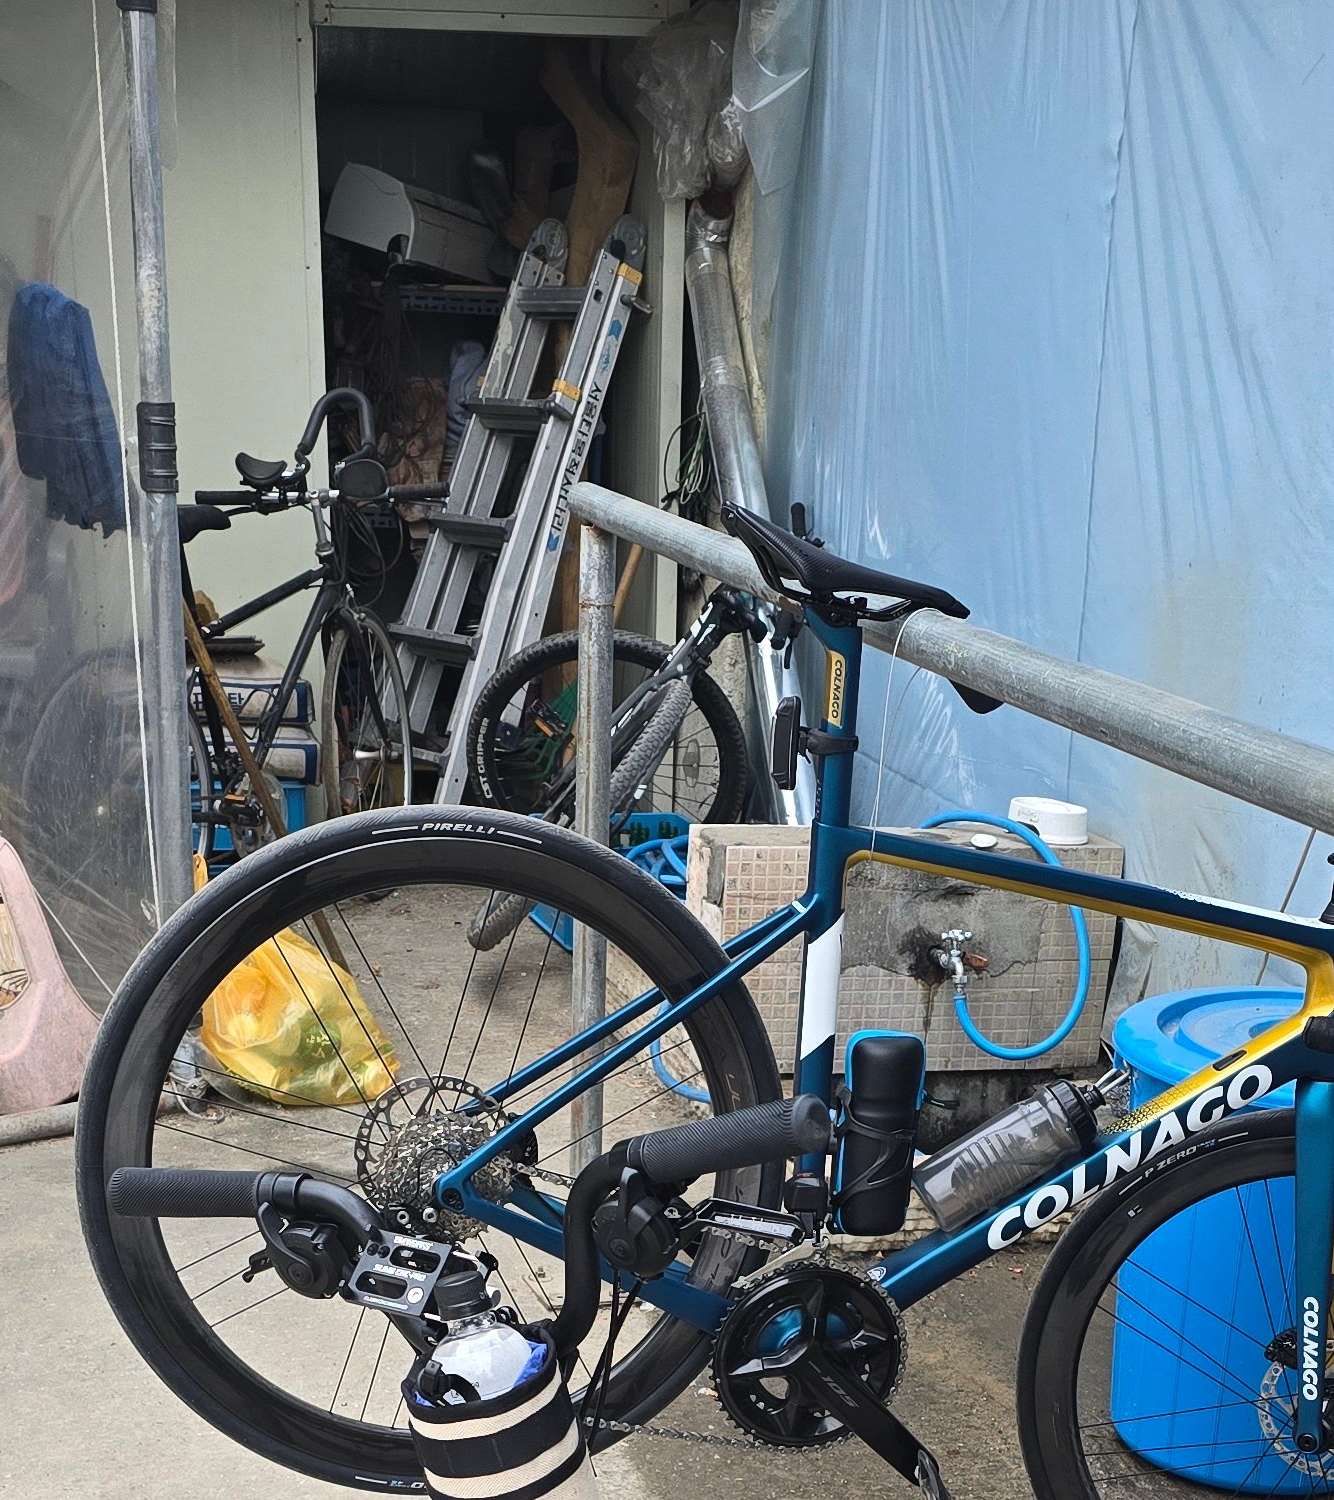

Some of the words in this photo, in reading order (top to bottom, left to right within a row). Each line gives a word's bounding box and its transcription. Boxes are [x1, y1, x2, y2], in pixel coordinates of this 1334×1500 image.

[831, 658, 843, 719] COLNAGO
[477, 717, 490, 771] GRIPPER
[421, 822, 496, 835] PIRELLI
[987, 1064, 1273, 1251] COLNAGO
[1156, 1144, 1198, 1171] ZERO
[1300, 1296, 1319, 1402] COLNAGO
[820, 1375, 860, 1409] 105
